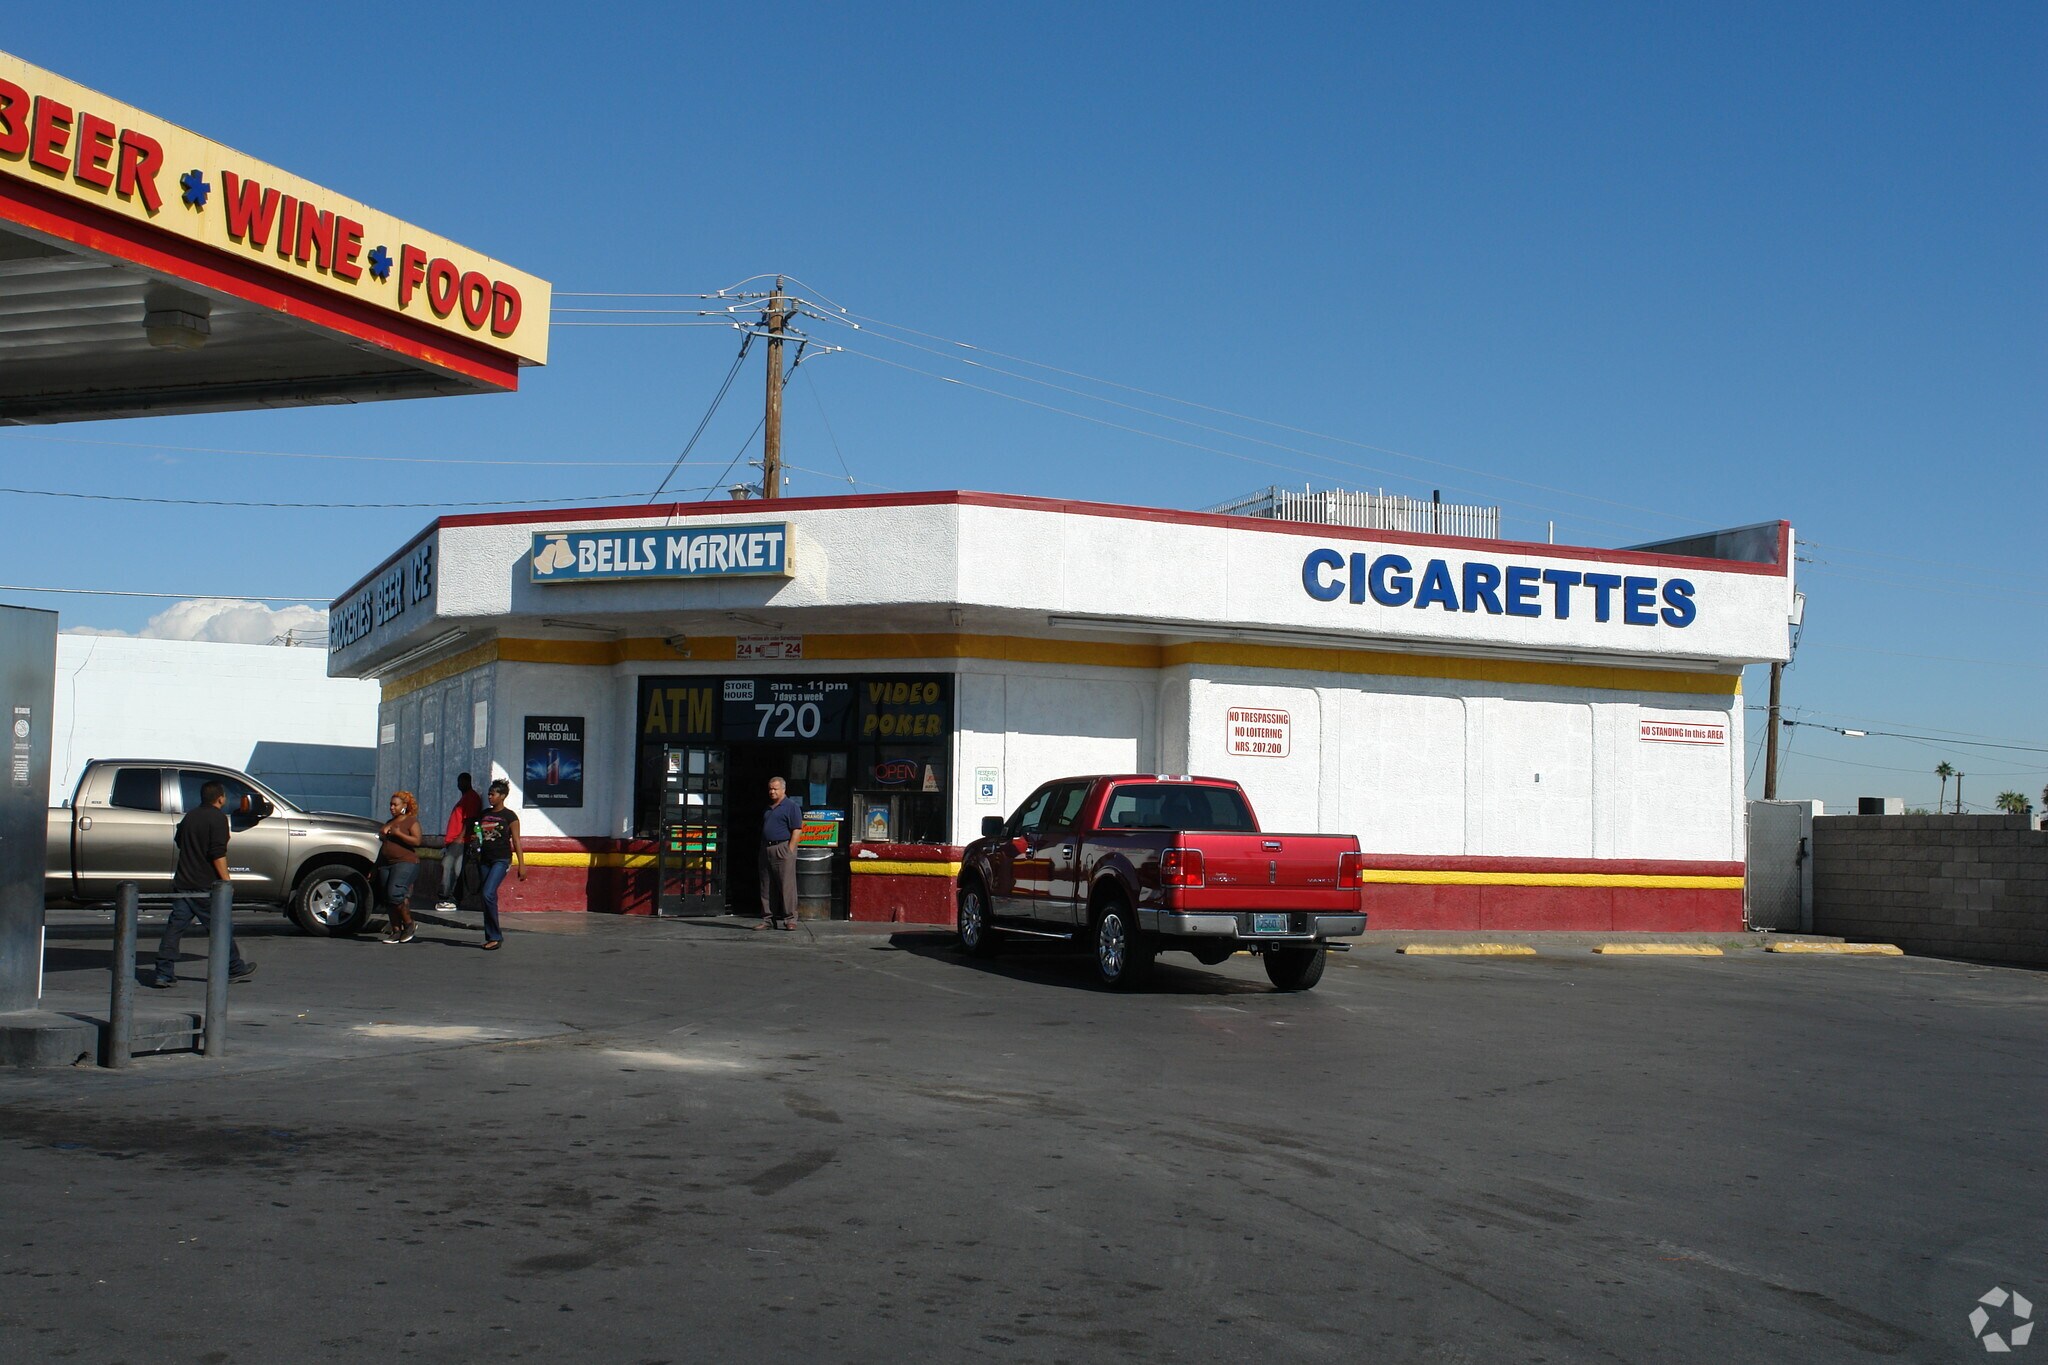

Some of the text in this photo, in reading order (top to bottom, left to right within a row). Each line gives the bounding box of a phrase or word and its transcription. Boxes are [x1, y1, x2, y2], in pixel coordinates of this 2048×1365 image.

[0, 78, 163, 213] BEER
[222, 169, 365, 281] WINE
[399, 243, 523, 337] FOOD
[577, 531, 783, 574] BELLS MARKET
[1301, 548, 1697, 628] CIGARETTES
[329, 545, 432, 654] GROCERIES BEER ICE
[737, 644, 752, 655] 24
[785, 643, 801, 654] 24
[725, 682, 753, 690] STORE
[770, 683, 793, 691] am
[807, 680, 849, 692] 11pm
[724, 691, 753, 699] HOURS
[774, 692, 778, 701] 7
[778, 692, 798, 702] days
[804, 692, 824, 701] week
[869, 682, 941, 705] VIDEO
[645, 688, 713, 734] ATM
[1229, 711, 1289, 725] NO TRESPASSING
[538, 722, 569, 732] THE COLA
[754, 703, 821, 738] 720
[863, 713, 943, 737] POKER
[527, 732, 580, 742] FROM RED BULL.
[1234, 726, 1283, 739] NO LOITERING
[1641, 726, 1651, 735] NO
[1652, 726, 1684, 738] STANDING
[1693, 729, 1706, 739] this
[1707, 730, 1724, 740] AREA
[1235, 741, 1282, 754] NRS. 207.200
[874, 763, 917, 780] OPEN
